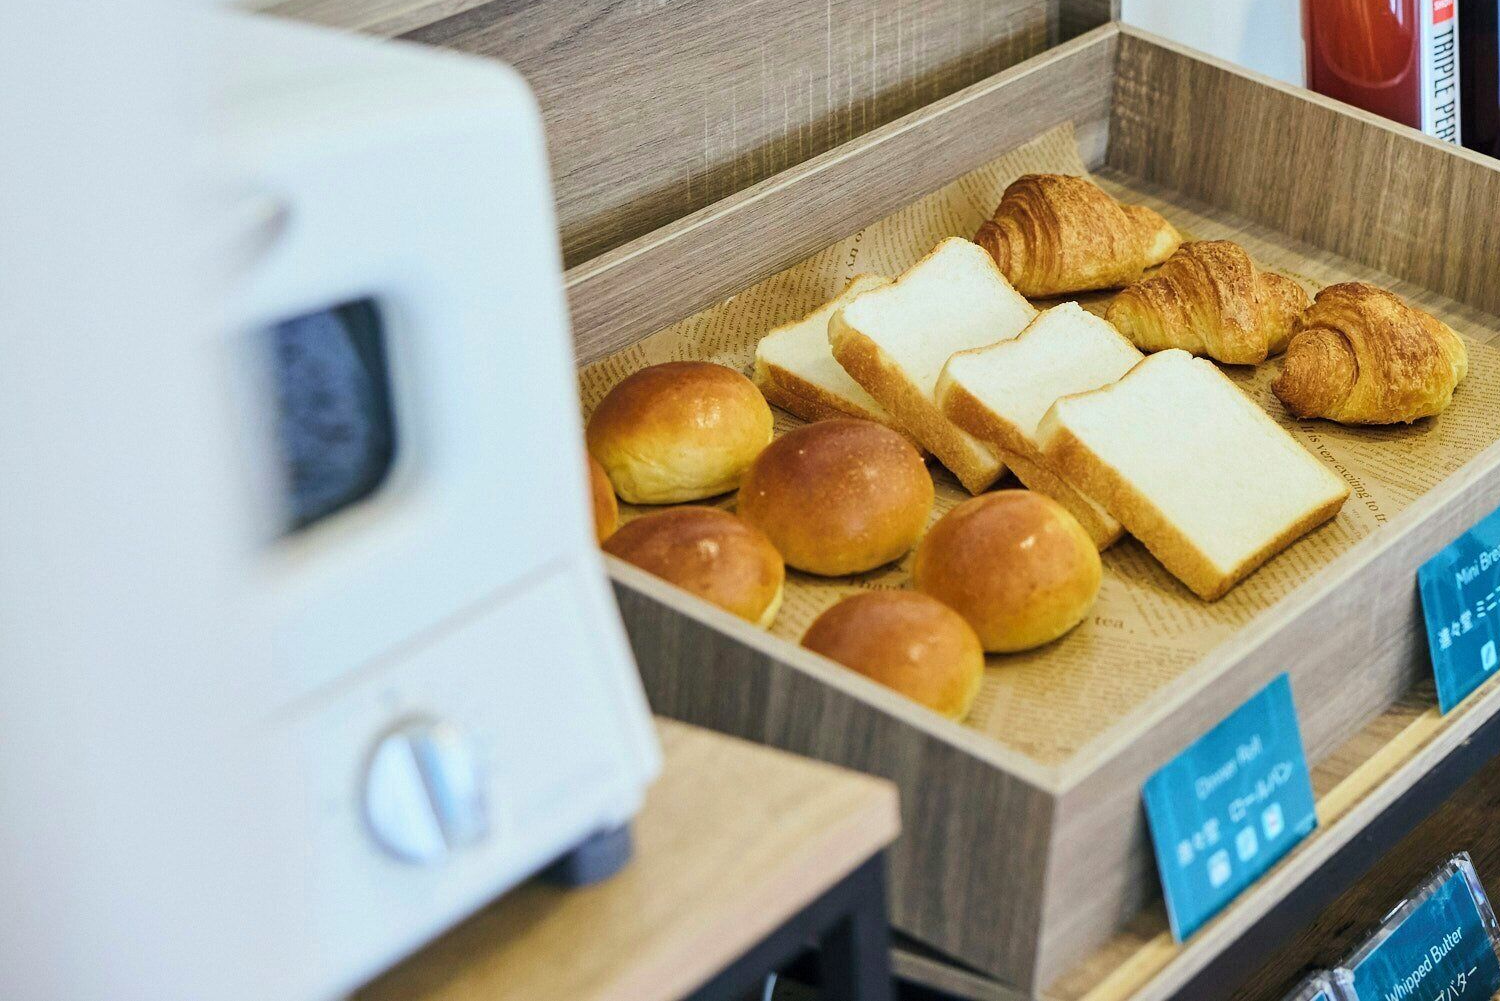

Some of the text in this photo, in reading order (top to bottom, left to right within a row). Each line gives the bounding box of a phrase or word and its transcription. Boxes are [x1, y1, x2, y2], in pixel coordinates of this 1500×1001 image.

[1433, 27, 1456, 98] TRIPLE
[1435, 99, 1456, 145] PER
[1335, 464, 1371, 500] exciting
[1455, 557, 1479, 590] Mini
[1385, 926, 1463, 1001] Whipped Butter
